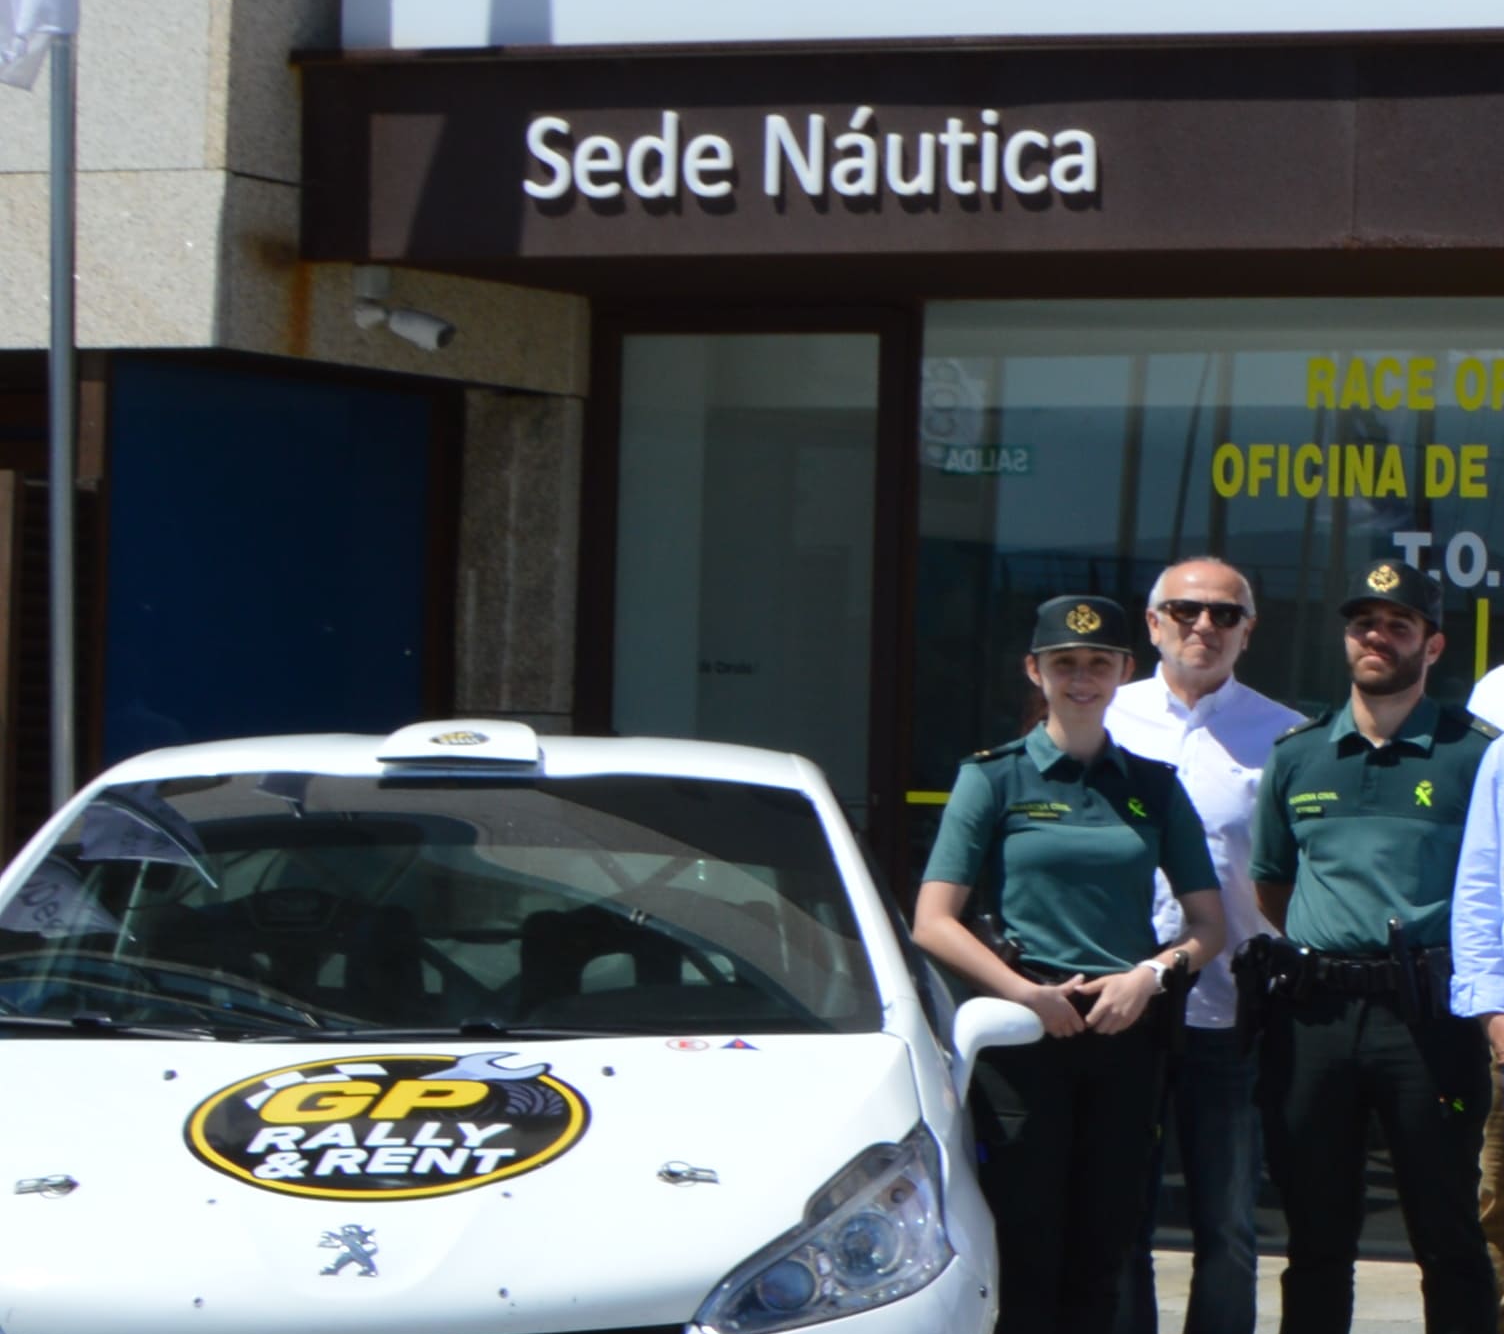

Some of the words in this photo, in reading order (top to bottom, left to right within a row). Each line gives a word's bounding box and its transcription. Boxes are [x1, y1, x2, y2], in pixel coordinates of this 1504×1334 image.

[524, 113, 731, 198] Sede
[764, 105, 1100, 197] Náutica
[1307, 357, 1435, 410] RACE
[1213, 444, 1406, 497] OFICINA
[1426, 445, 1488, 497] DE
[259, 1079, 490, 1124] GP
[246, 1122, 512, 1154] RALLY
[253, 1151, 309, 1180] &
[313, 1147, 516, 1176] RENT
